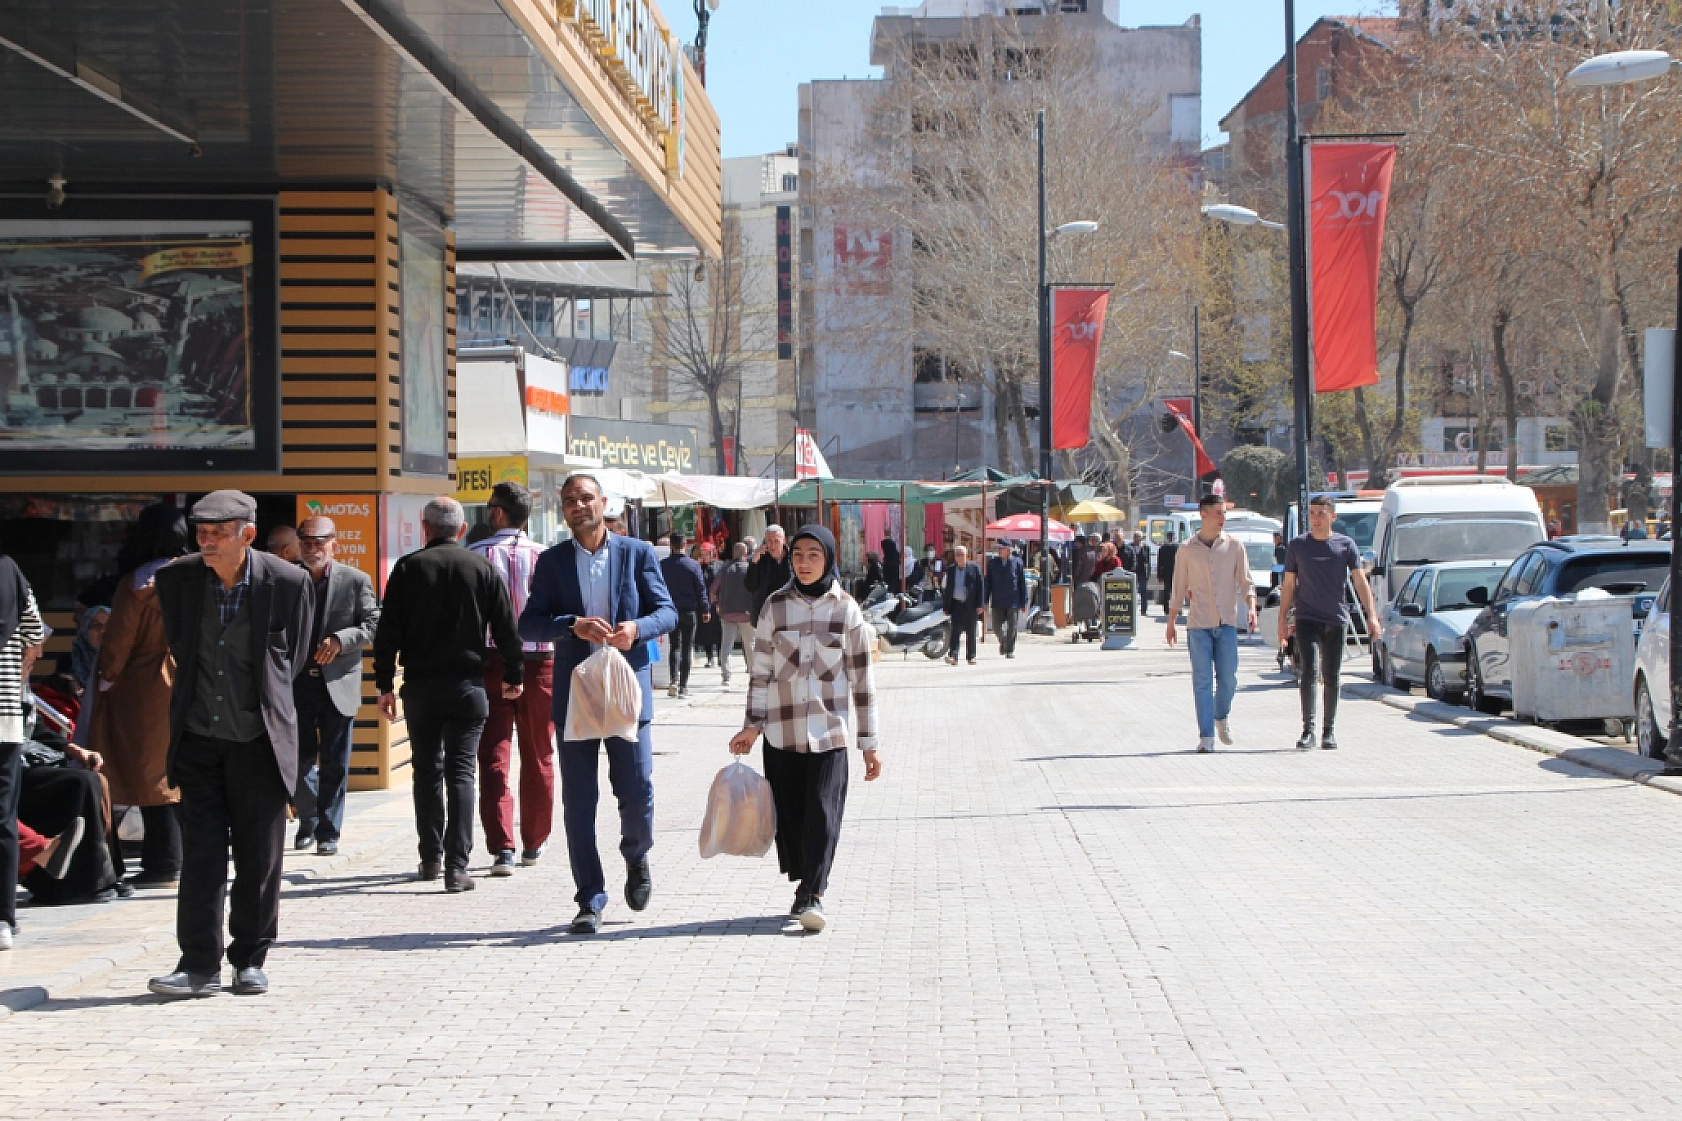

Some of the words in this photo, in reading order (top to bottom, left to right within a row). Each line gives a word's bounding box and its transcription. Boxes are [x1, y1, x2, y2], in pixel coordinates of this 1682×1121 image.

[598, 435, 639, 466] Perde
[641, 441, 657, 468] ve
[658, 439, 692, 473] Çeyiz
[323, 503, 370, 518] MOTAŞ
